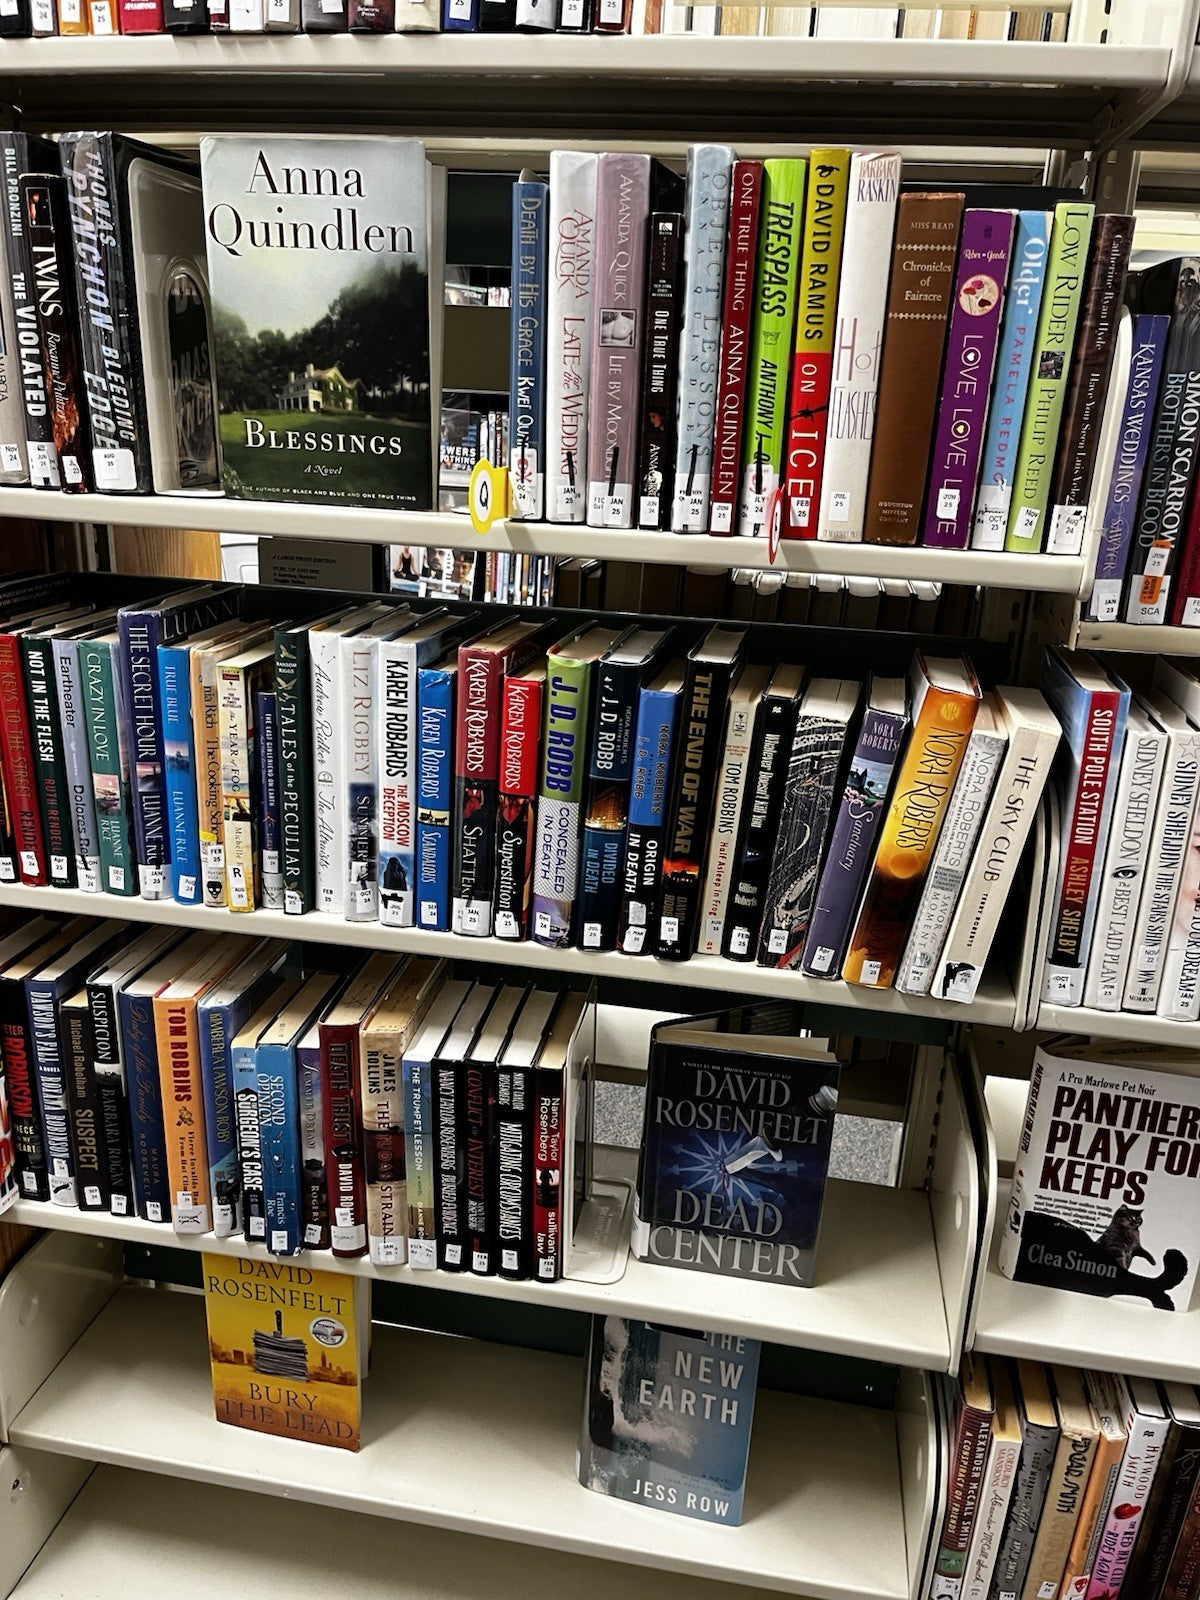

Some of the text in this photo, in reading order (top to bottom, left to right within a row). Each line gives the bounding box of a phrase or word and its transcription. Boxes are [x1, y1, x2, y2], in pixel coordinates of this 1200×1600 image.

[5, 148, 23, 237] BILL PRONZINI
[86, 151, 116, 247] THOMAS
[245, 150, 366, 198] Anna
[208, 203, 417, 256] Quindlen
[520, 197, 542, 245] DEATH
[609, 174, 633, 301] AMANDA QUICK
[63, 166, 115, 332] PYNCHON
[519, 256, 537, 275] BY
[555, 217, 579, 292] QUICK
[574, 208, 593, 298] AMANDA
[760, 200, 795, 318] TRESPASS
[804, 184, 835, 341] DAVID RAMUS
[902, 260, 952, 273] Chronicles
[32, 242, 63, 317] TWINS
[904, 290, 942, 301] Fairacre
[920, 276, 931, 287] of
[1046, 210, 1089, 345] LOW RIDER
[12, 272, 47, 417] THE VIOLATED
[517, 316, 538, 367] GRACE
[653, 334, 668, 359] TRUE
[654, 310, 669, 330] ONE
[718, 172, 755, 495] ONE TRUE THING ANNA QUINDLEN
[101, 344, 137, 442] BLEEDING
[517, 376, 535, 409] KWEI
[607, 355, 626, 401] LIE BY
[651, 364, 667, 393] THING
[757, 358, 778, 430] ANTHONY
[243, 418, 402, 456] BLESSINGS
[560, 393, 584, 476] WEDDING
[787, 363, 819, 497] ON ICE
[1114, 342, 1156, 503] KANSAS WEDDINGS
[304, 464, 343, 477] A Novel
[479, 481, 489, 510] Q
[1024, 453, 1046, 499] REED
[1140, 606, 1160, 616] SCA
[28, 651, 54, 762] NOT IN THE FLESH
[59, 656, 76, 729] Eartheater
[86, 653, 110, 762] CRAZY IN LOVE
[128, 624, 156, 758] THE SECRET HOUR
[353, 651, 372, 775] LIZ RIGBEY
[465, 658, 490, 772] KAREN ROBARDS
[281, 704, 297, 760] TALES
[386, 659, 408, 778] KAREN ROBARDS
[505, 684, 529, 790] KAREN ROBARDS
[421, 707, 447, 799] KAREN ROBARDS
[545, 731, 575, 793] ROBB
[725, 762, 742, 785] TOM
[1074, 709, 1114, 845] SOUTH POLE STATION
[284, 791, 299, 876] PECULIAR
[383, 788, 396, 841] DECEPTION
[396, 784, 410, 847] THE MOSCOW
[718, 787, 739, 835] ROBBINS
[983, 756, 1039, 883] THE SKY CLUB
[498, 830, 522, 909] Superstition
[625, 833, 641, 894] IN DEATH
[643, 839, 658, 886] ORIGIN
[1058, 857, 1090, 955] ASHLEY SHELBY
[91, 991, 112, 1060] SUSPICION
[167, 1007, 192, 1102] TOM ROBBINS
[367, 1050, 380, 1094] ROLLINS
[382, 1054, 395, 1092] JAMES
[257, 1073, 272, 1127] OPINION
[271, 1076, 286, 1126] SECOND
[695, 1070, 790, 1108] DAVID
[1059, 1072, 1156, 1096] A Pru Marlowe Pet Noir
[237, 1093, 262, 1159] SURGEON'S
[377, 1101, 390, 1130] THE
[411, 1067, 422, 1171] THE TRUMPET LESSON
[538, 1097, 549, 1161] Rosenberg
[550, 1098, 560, 1161] Nancy Taylor
[655, 1096, 827, 1144] ROSENFELT
[1052, 1085, 1200, 1140] PANTHER
[1045, 1119, 1140, 1169] PLAY
[242, 1160, 263, 1192] CASE
[1039, 1155, 1148, 1206] KEEPS
[674, 1189, 783, 1237] DEAD
[238, 1258, 314, 1286] DAVID
[650, 1225, 804, 1280] CENTER
[1027, 1244, 1118, 1279] Clea Simon
[208, 1276, 346, 1315] ROSENFELT
[675, 1350, 743, 1390] NEW
[703, 1331, 746, 1355] THE
[219, 1398, 353, 1439] THE LEAD
[249, 1382, 318, 1412] BURY
[639, 1379, 738, 1426] EARTH
[970, 1421, 990, 1477] ALEXANDER
[1122, 1452, 1137, 1488] SMITH
[1135, 1445, 1160, 1499] HAYWOOD
[633, 1479, 677, 1504] JESS
[686, 1493, 730, 1517] ROW
